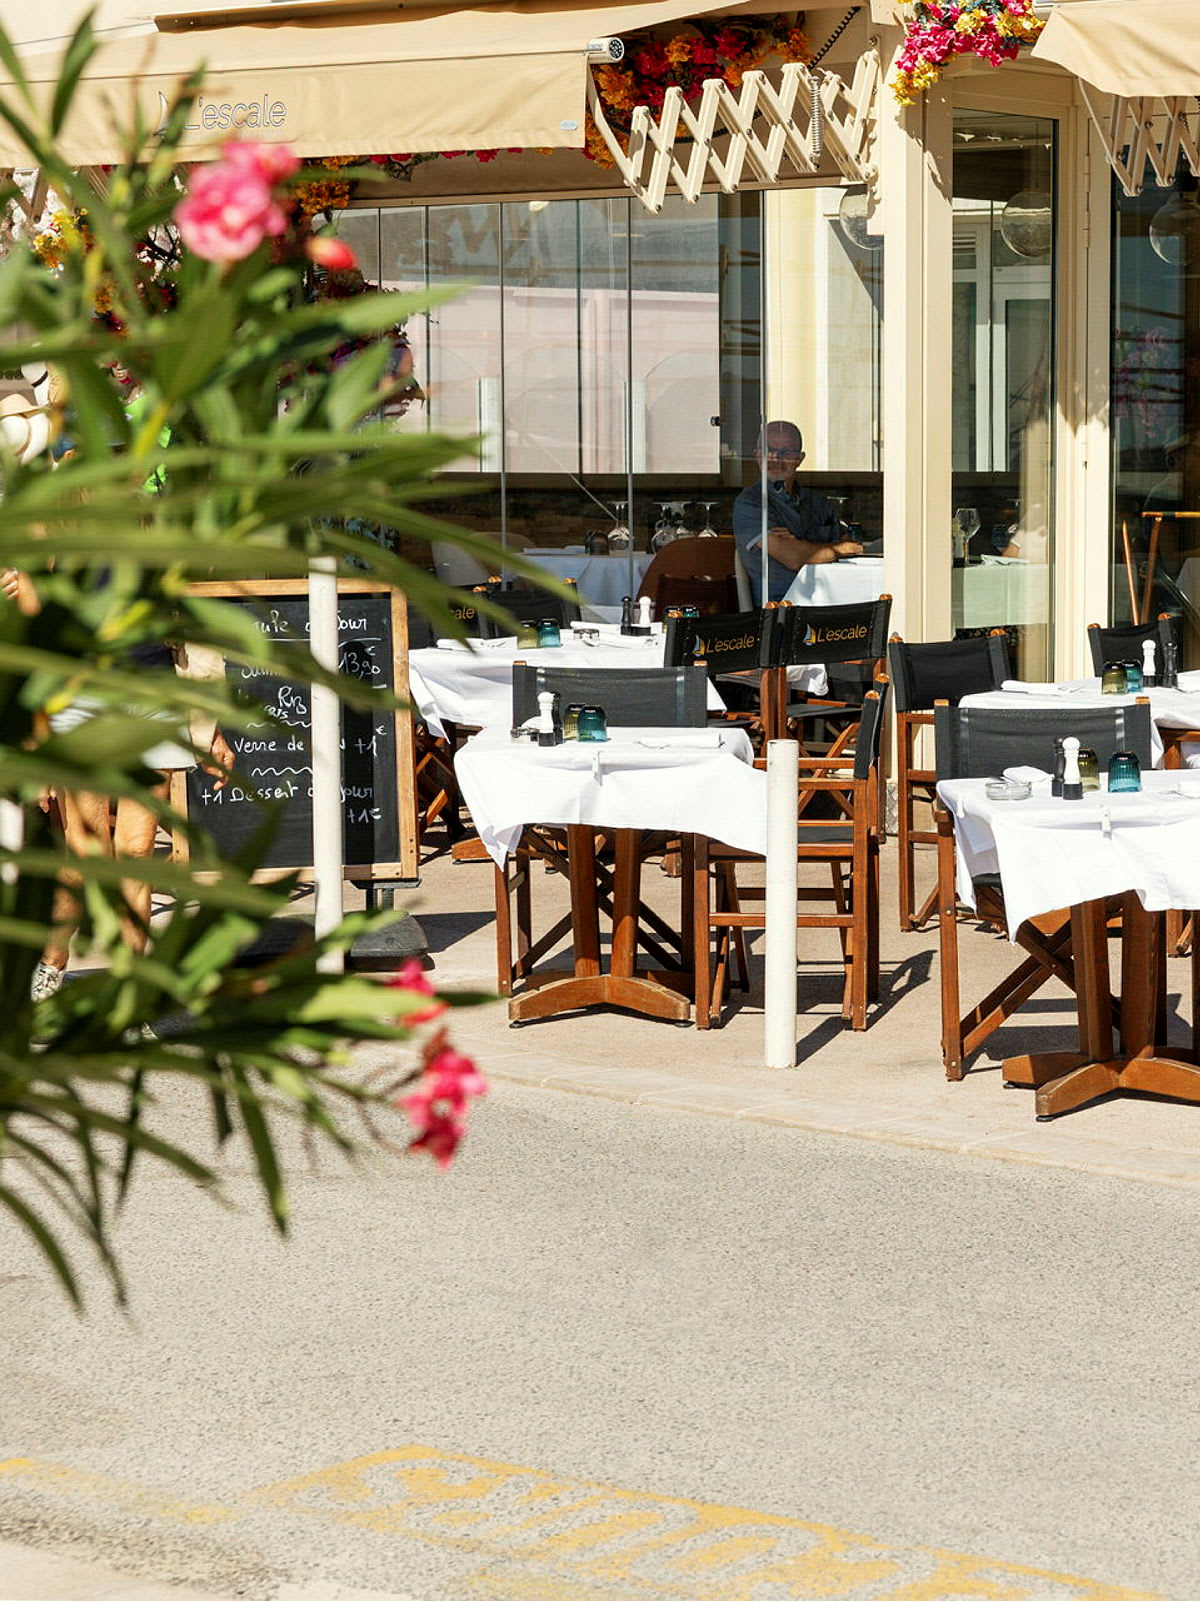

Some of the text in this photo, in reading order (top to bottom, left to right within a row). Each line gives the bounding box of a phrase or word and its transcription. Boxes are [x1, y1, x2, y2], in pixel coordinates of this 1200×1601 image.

[705, 632, 756, 655] L'escale
[816, 622, 868, 644] L'escale
[287, 734, 305, 751] de
